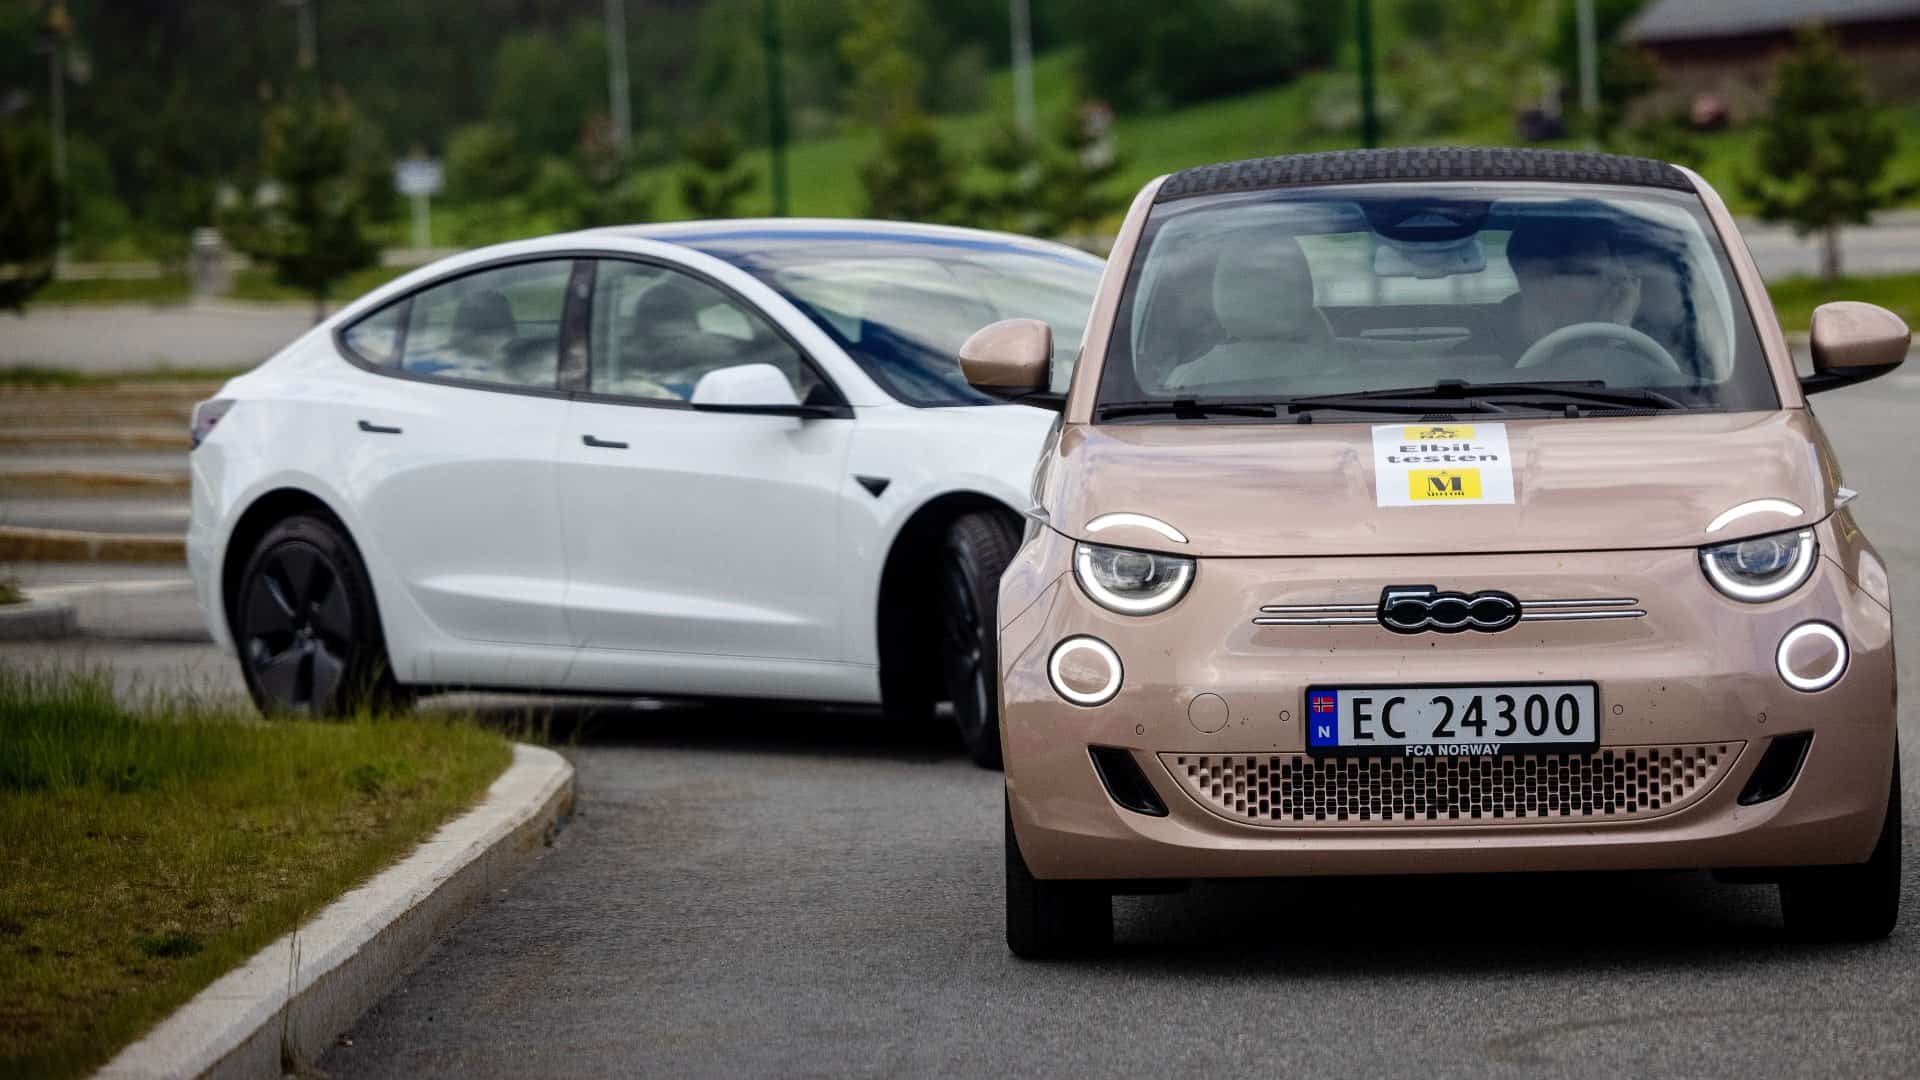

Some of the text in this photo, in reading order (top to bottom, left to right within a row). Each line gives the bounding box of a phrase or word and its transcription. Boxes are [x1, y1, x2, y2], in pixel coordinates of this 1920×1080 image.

[1399, 443, 1485, 453] Elbil-
[1386, 454, 1499, 464] testen
[1428, 476, 1463, 491] M
[1382, 589, 1518, 630] 500
[1352, 693, 1580, 739] EC 24300
[1318, 725, 1331, 739] N
[1405, 743, 1501, 757] FCA NORWAY
